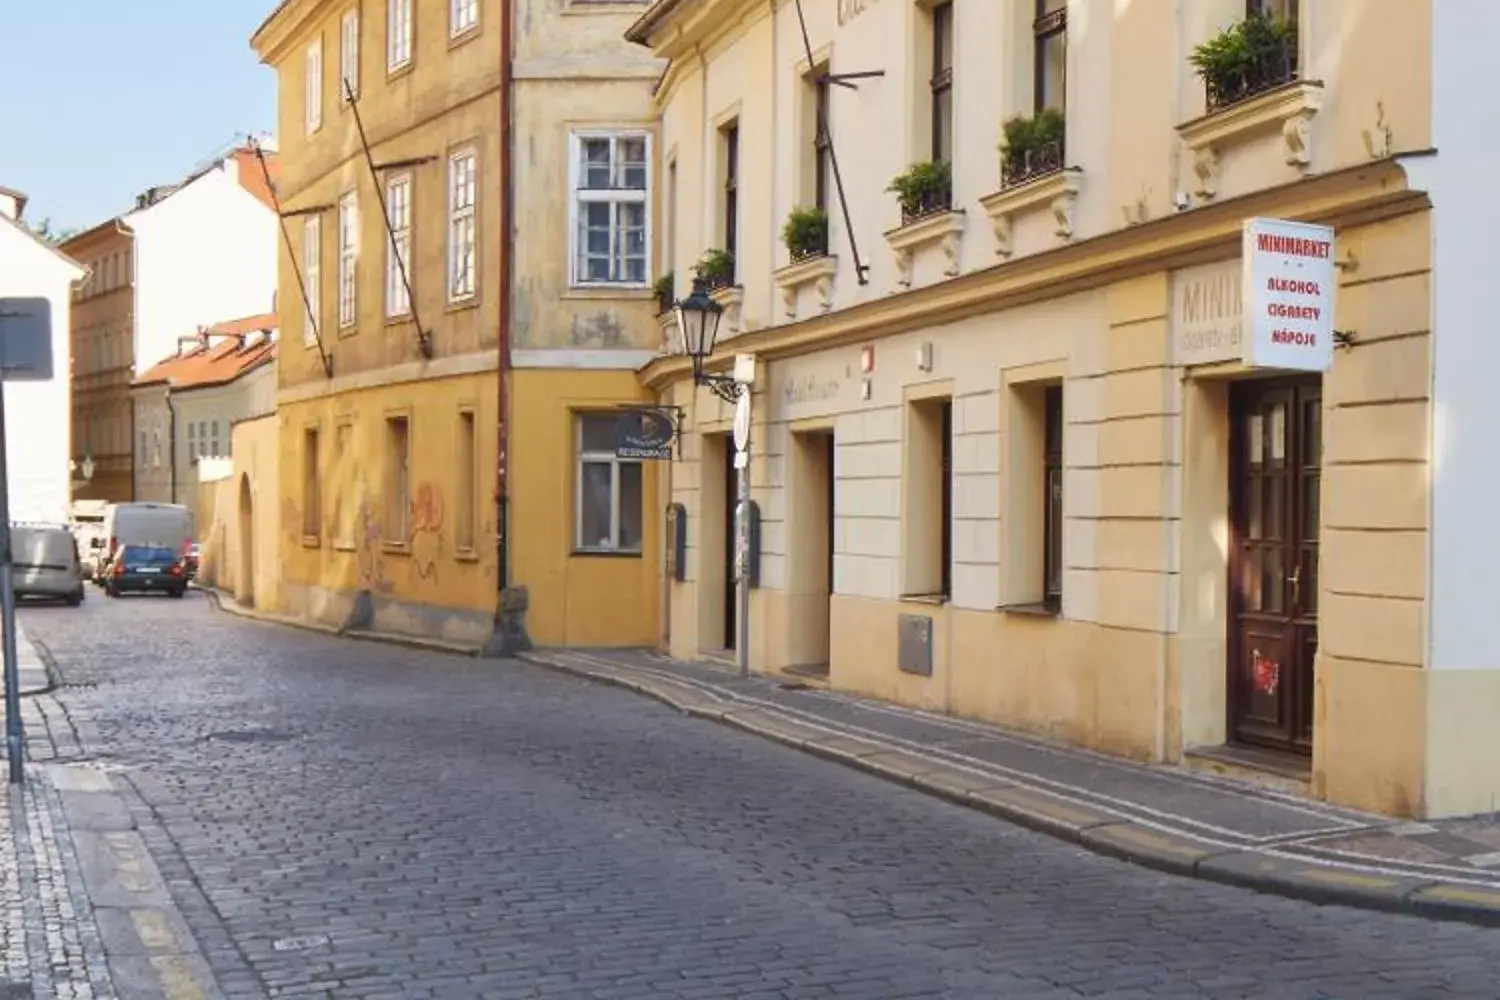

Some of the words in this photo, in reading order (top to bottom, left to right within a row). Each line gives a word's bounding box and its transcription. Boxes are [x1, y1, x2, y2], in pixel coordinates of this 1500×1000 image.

[1257, 233, 1331, 258] MINIMARKET
[1267, 277, 1321, 296] ALKOHOL
[1267, 303, 1321, 321] CIGARETY
[1271, 328, 1317, 347] NÁPOJE
